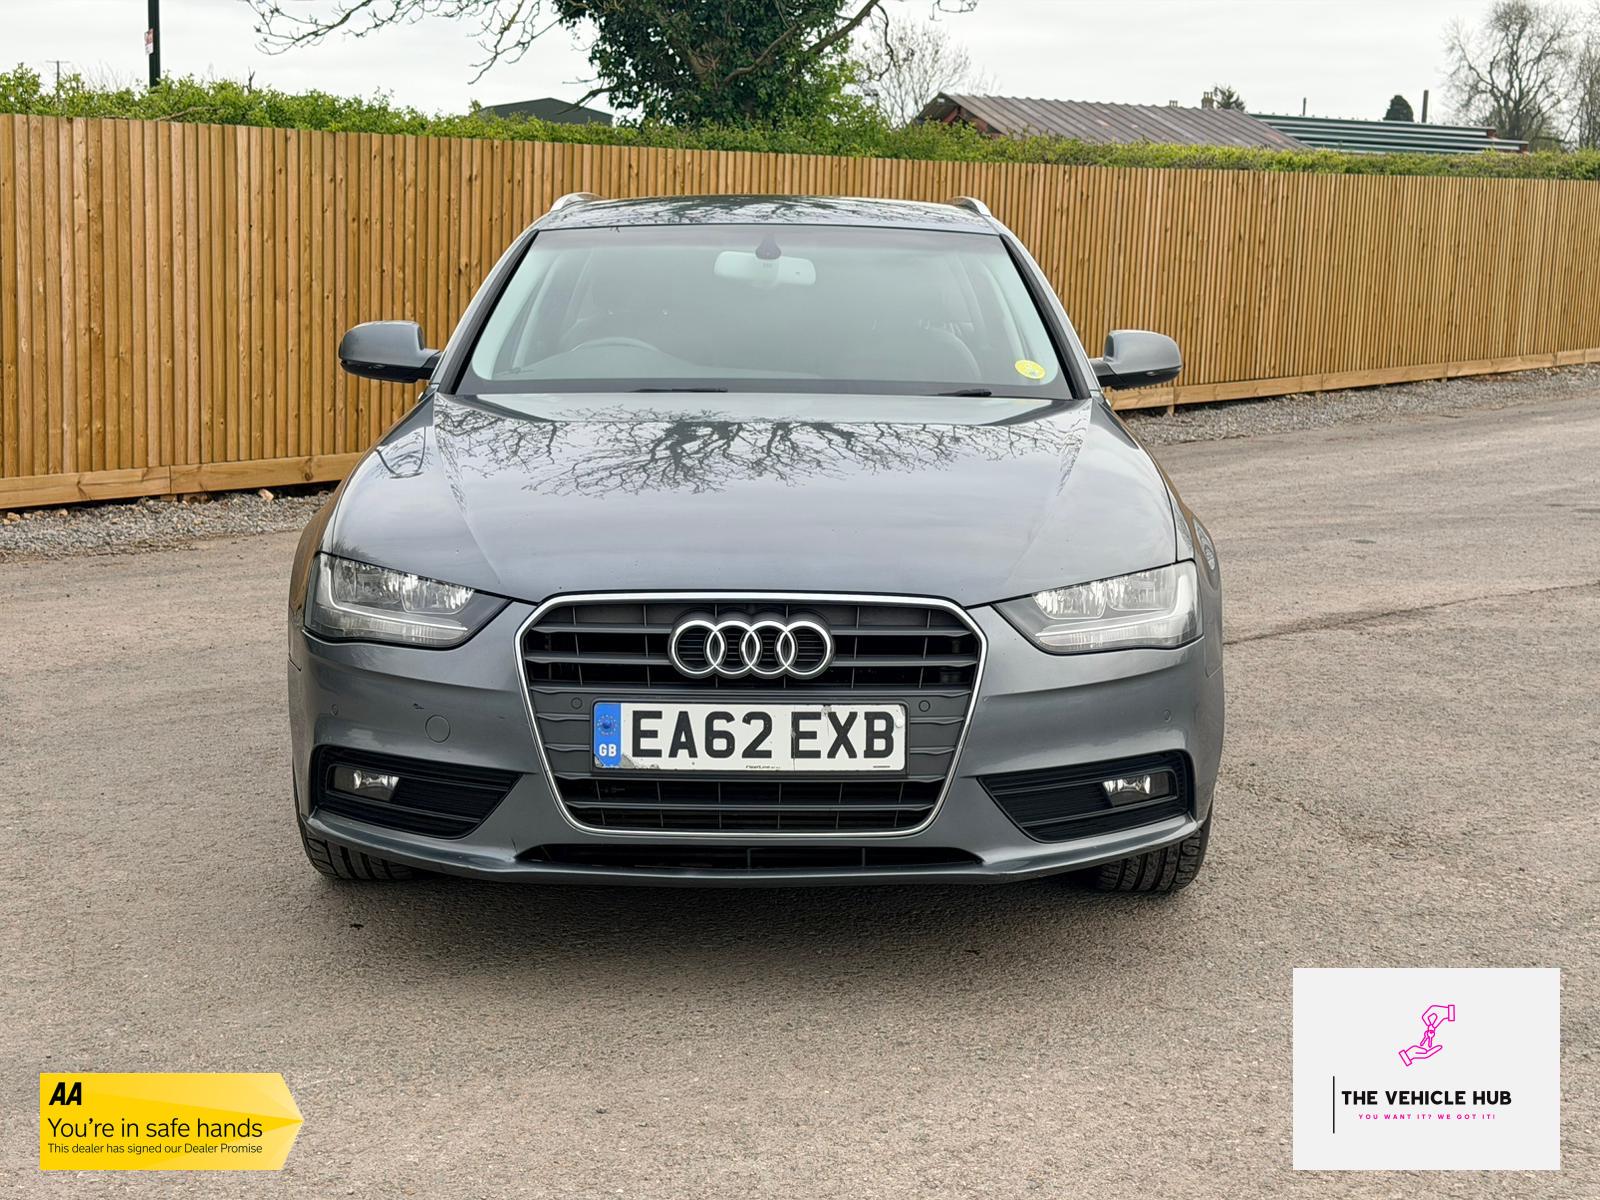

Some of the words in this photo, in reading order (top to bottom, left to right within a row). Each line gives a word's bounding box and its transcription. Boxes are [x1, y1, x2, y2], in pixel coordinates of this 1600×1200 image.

[599, 744, 616, 756] GB
[632, 710, 773, 759] EA62
[791, 711, 895, 760] EXB
